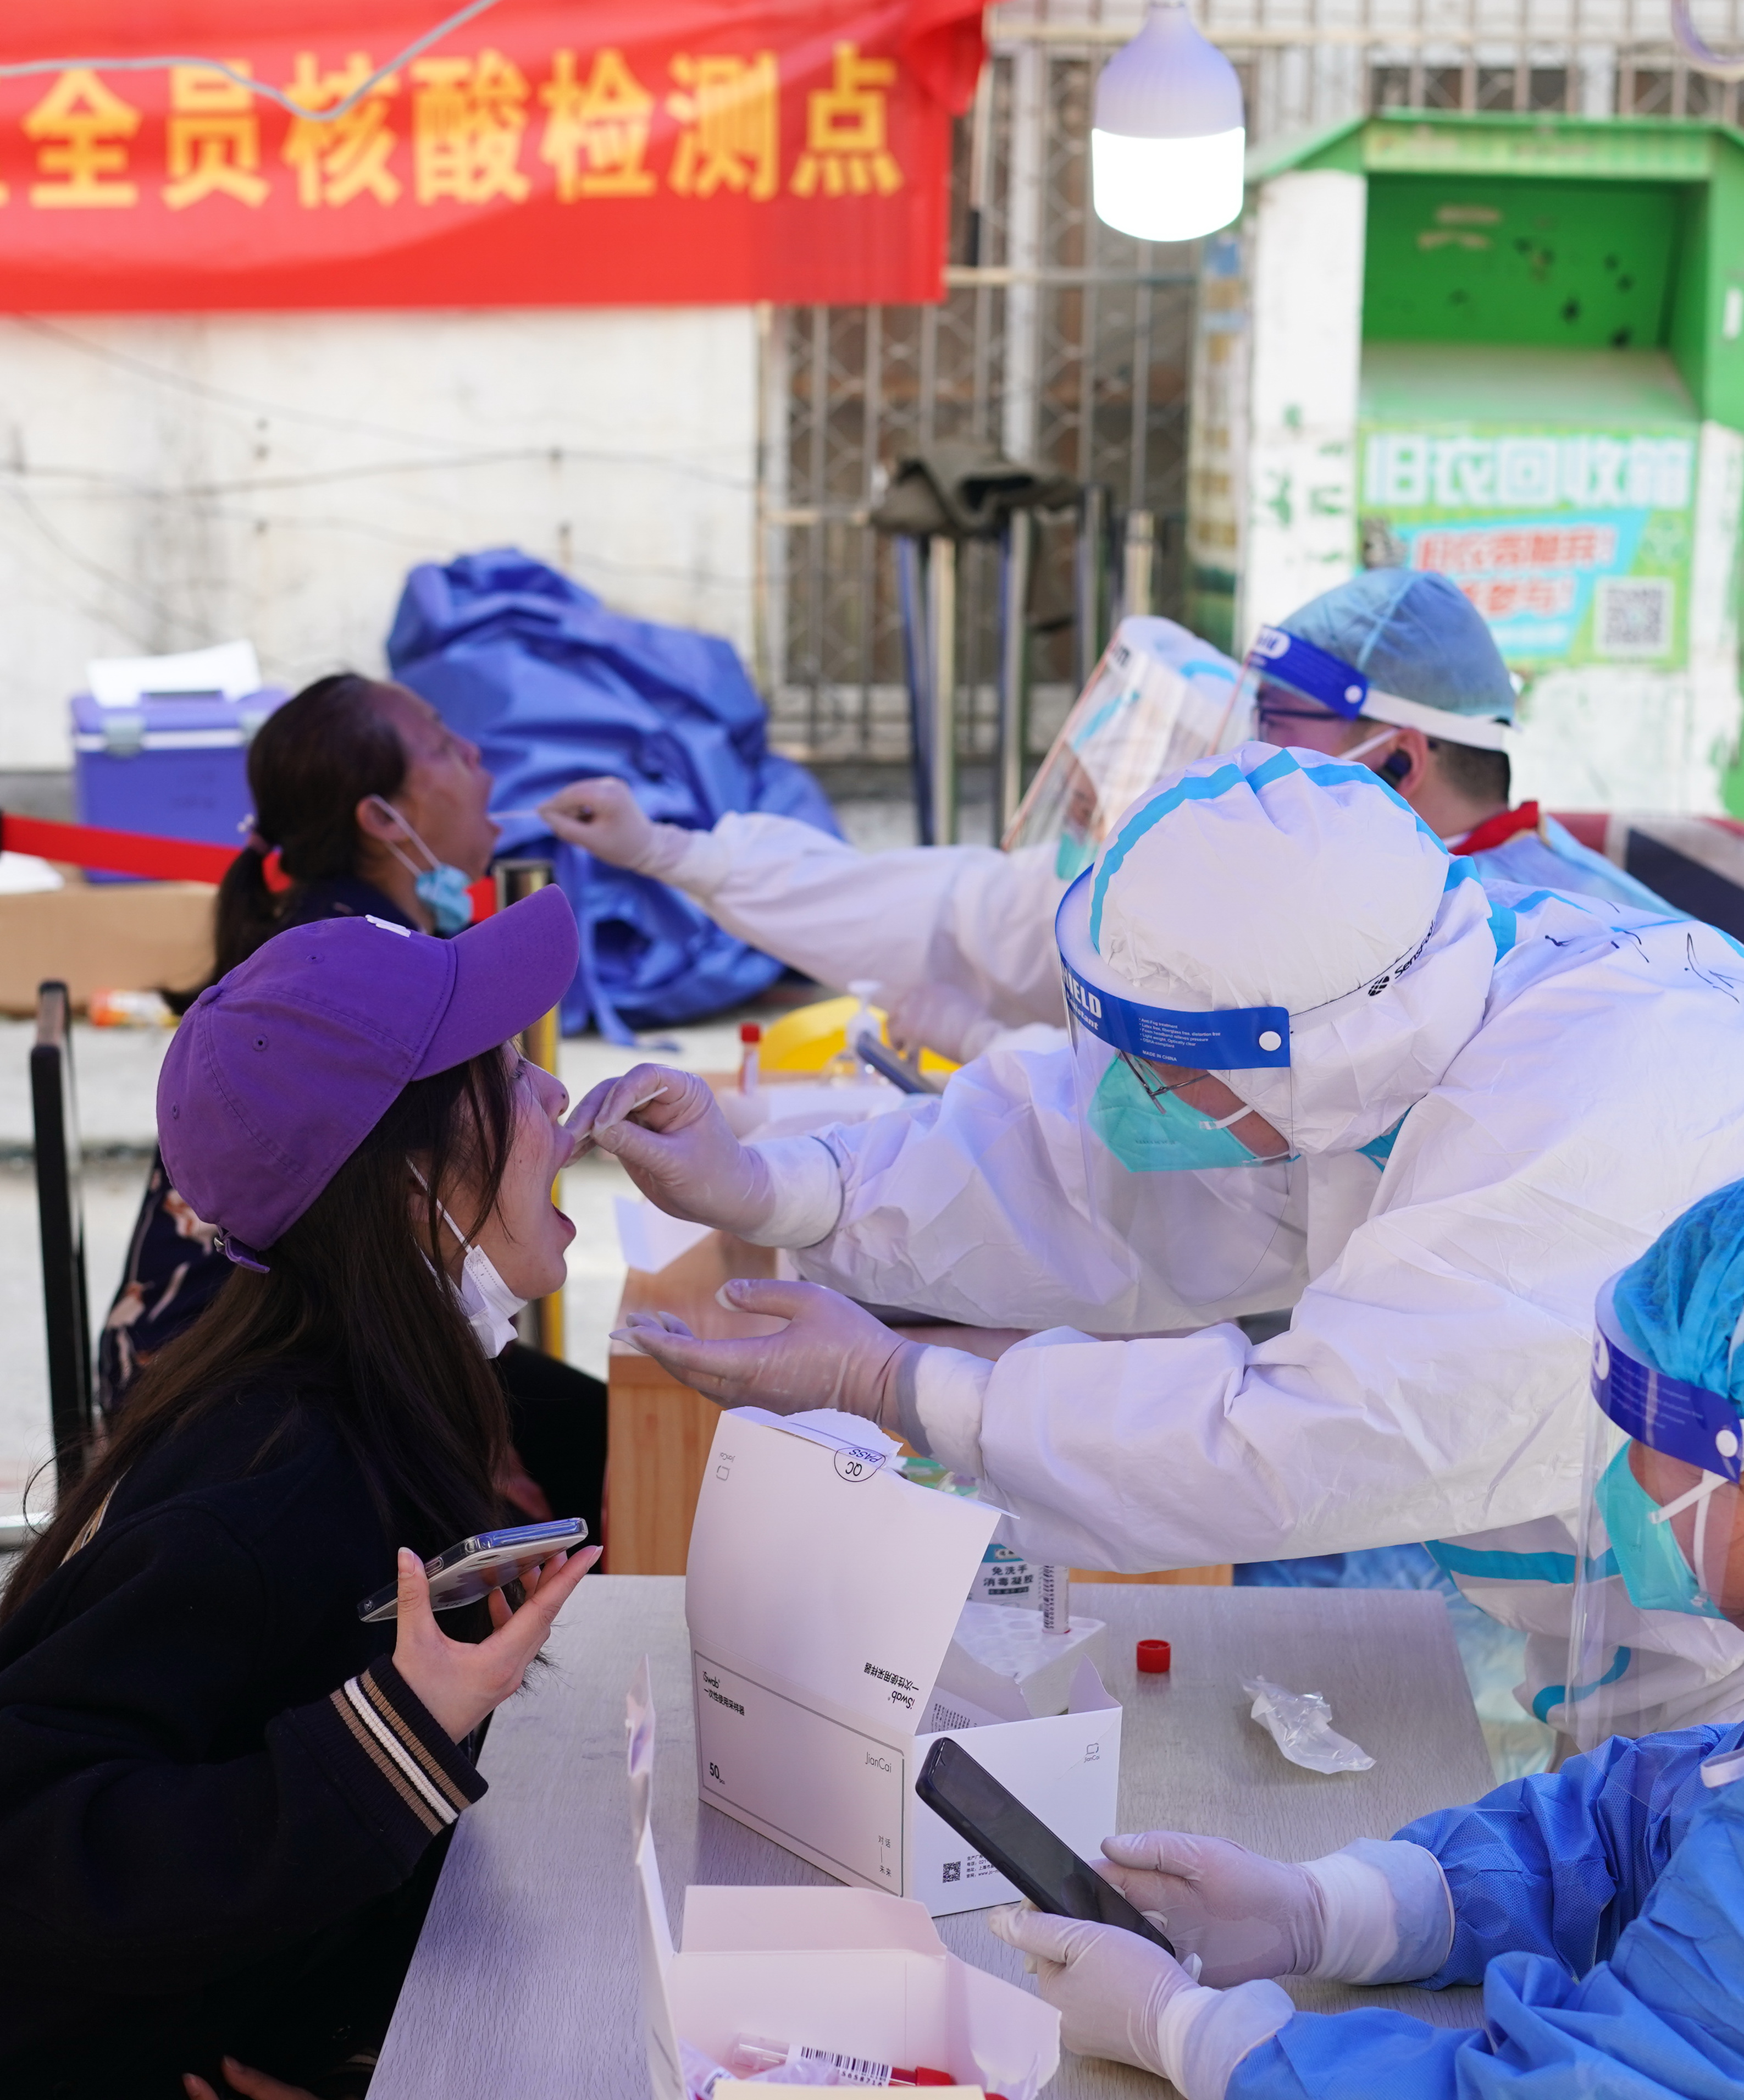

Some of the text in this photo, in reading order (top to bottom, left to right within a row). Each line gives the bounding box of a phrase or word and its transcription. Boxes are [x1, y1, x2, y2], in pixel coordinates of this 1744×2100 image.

[0, 43, 904, 212] 全员核酸检测点
[849, 1449, 883, 1463] PASS
[845, 1461, 862, 1477] QC
[992, 1564, 1028, 1576] 免洗手
[983, 1574, 1034, 1587] 消毒凝胶
[863, 1662, 919, 1691] 一次性使用采样器
[704, 1688, 745, 1716] 一次性使用采样器
[865, 1751, 892, 1773] JianCai
[878, 1835, 891, 1848] 对话
